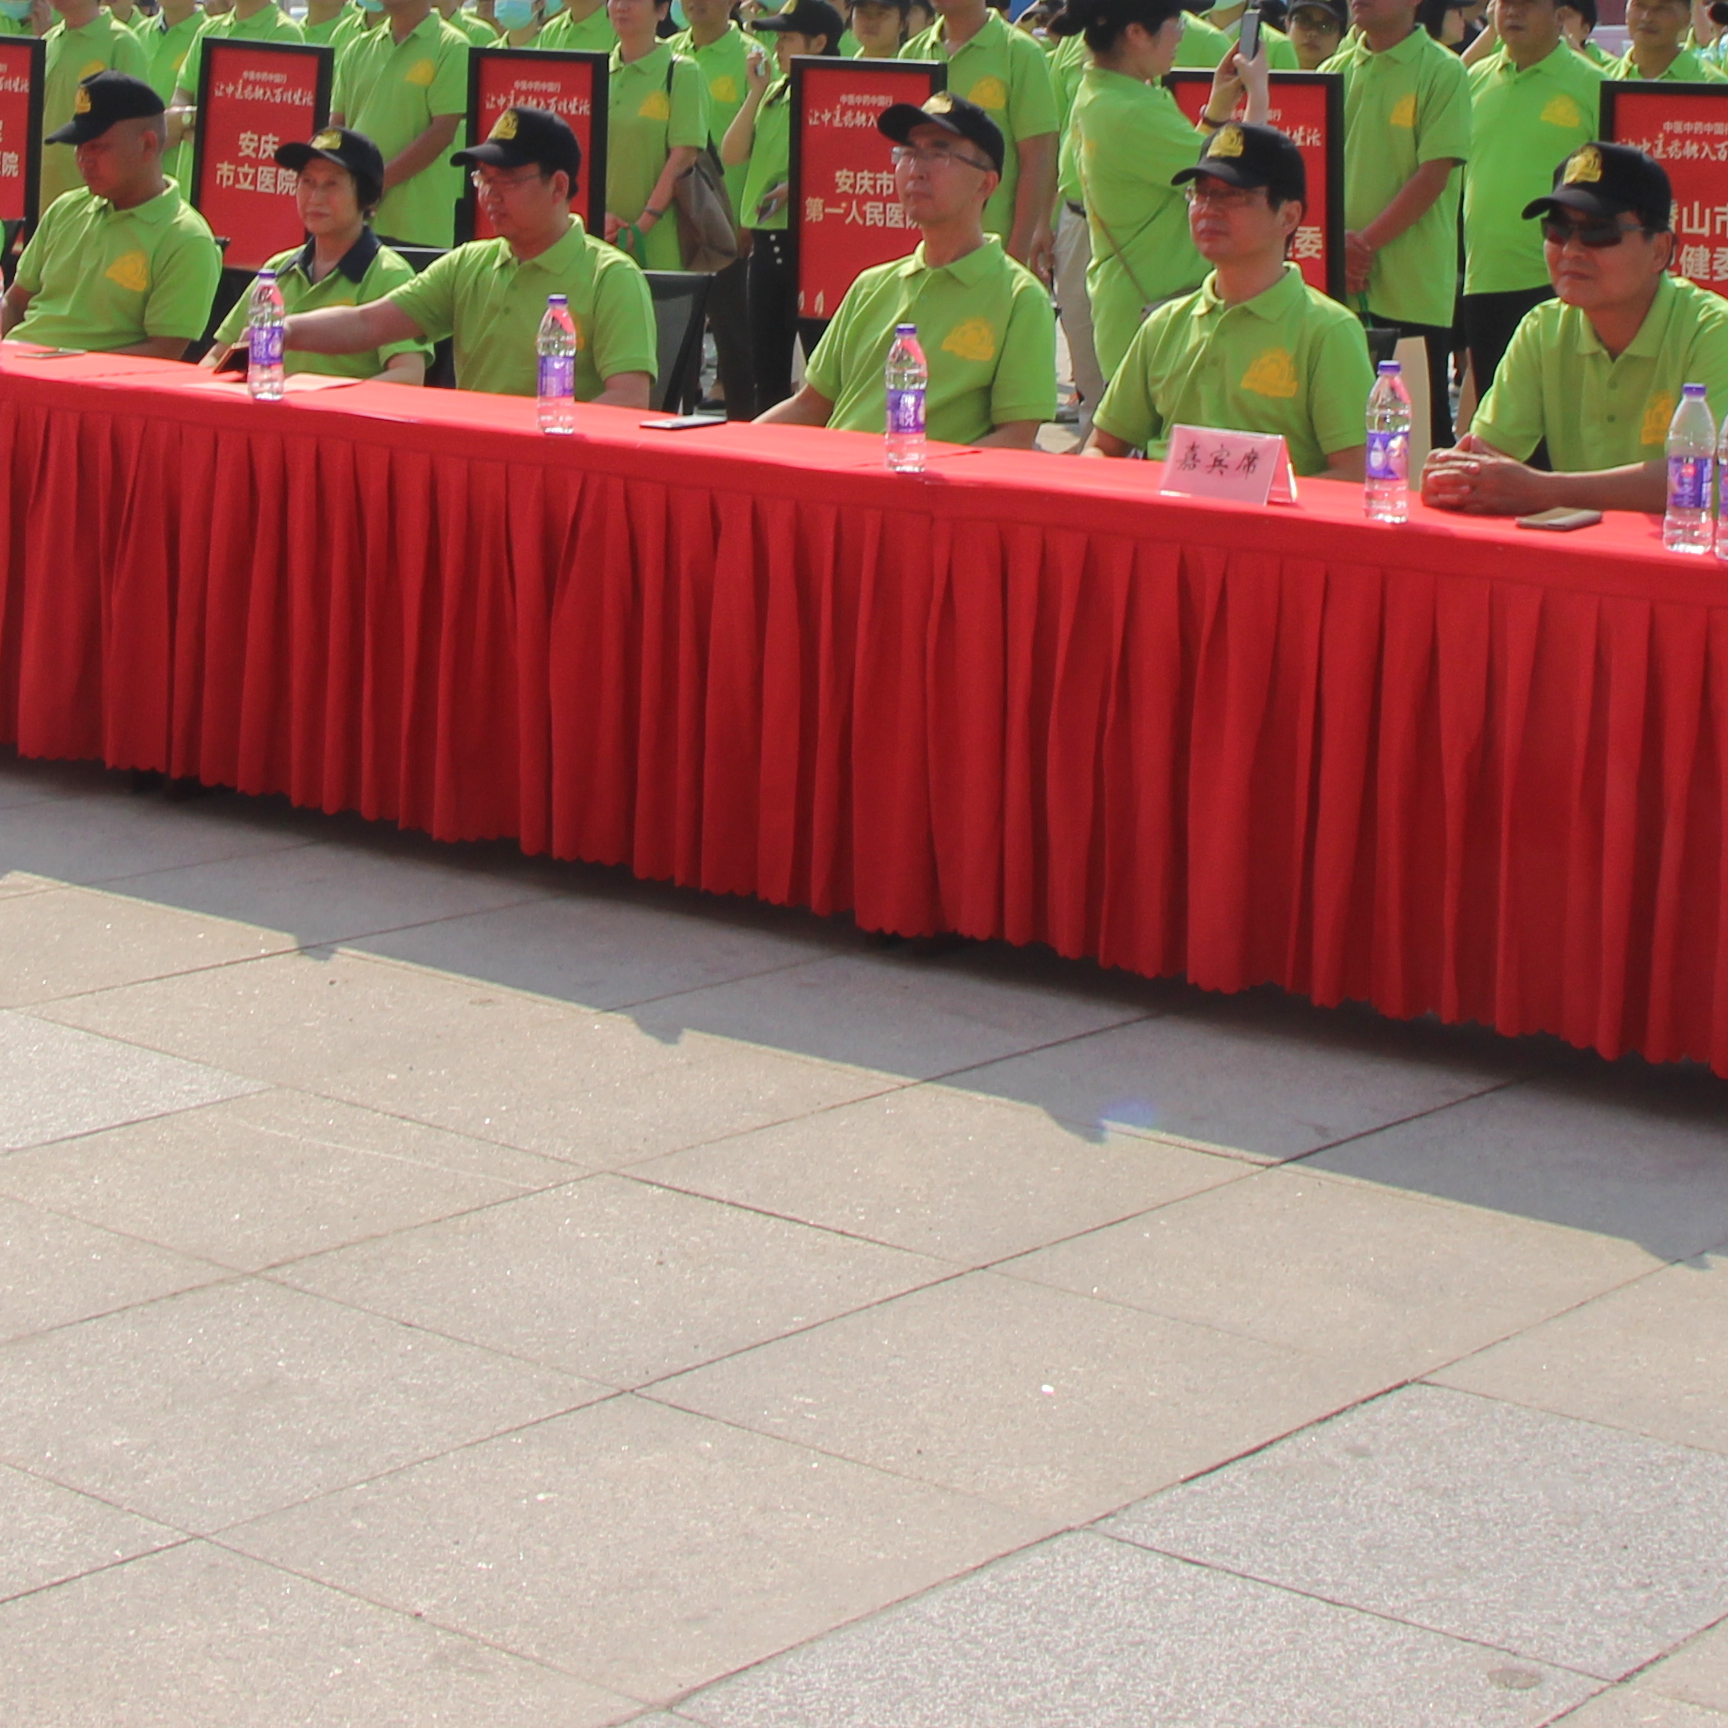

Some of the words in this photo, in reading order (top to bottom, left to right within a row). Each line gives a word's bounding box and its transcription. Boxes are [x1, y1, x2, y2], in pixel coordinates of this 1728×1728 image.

[808, 104, 880, 129] 让中医药融入
[238, 130, 280, 160] 安庆
[215, 160, 298, 197] 市立医院
[834, 167, 895, 198] 安庆市
[1177, 441, 1260, 480] 嘉宾席
